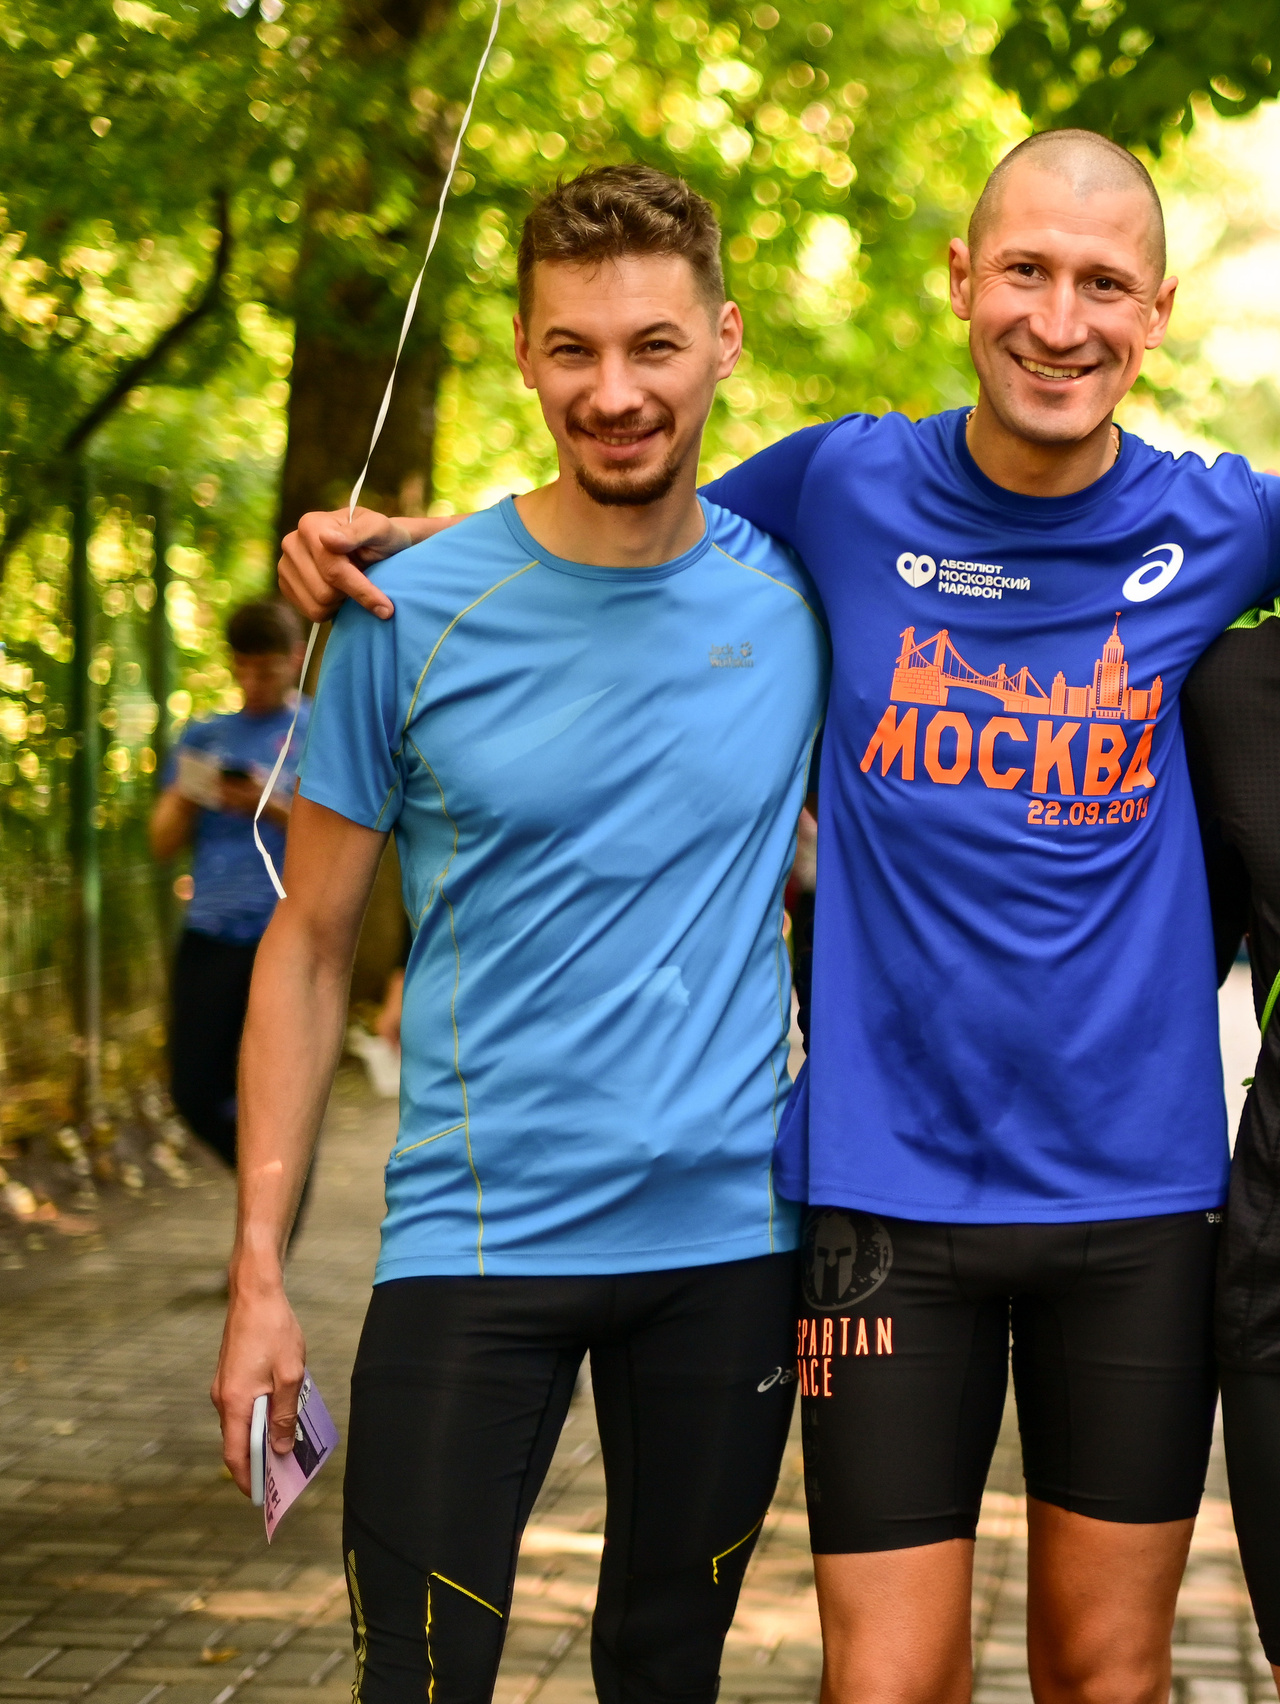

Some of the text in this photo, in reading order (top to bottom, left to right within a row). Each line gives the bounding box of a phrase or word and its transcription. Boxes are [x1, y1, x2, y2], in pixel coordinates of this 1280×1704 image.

[940, 559, 1003, 574] АБСОЛЮТ
[939, 569, 1031, 591] МОСКОВСКИЙ
[938, 581, 1003, 600] МАРАФОН
[860, 704, 1156, 796] МОСКВА
